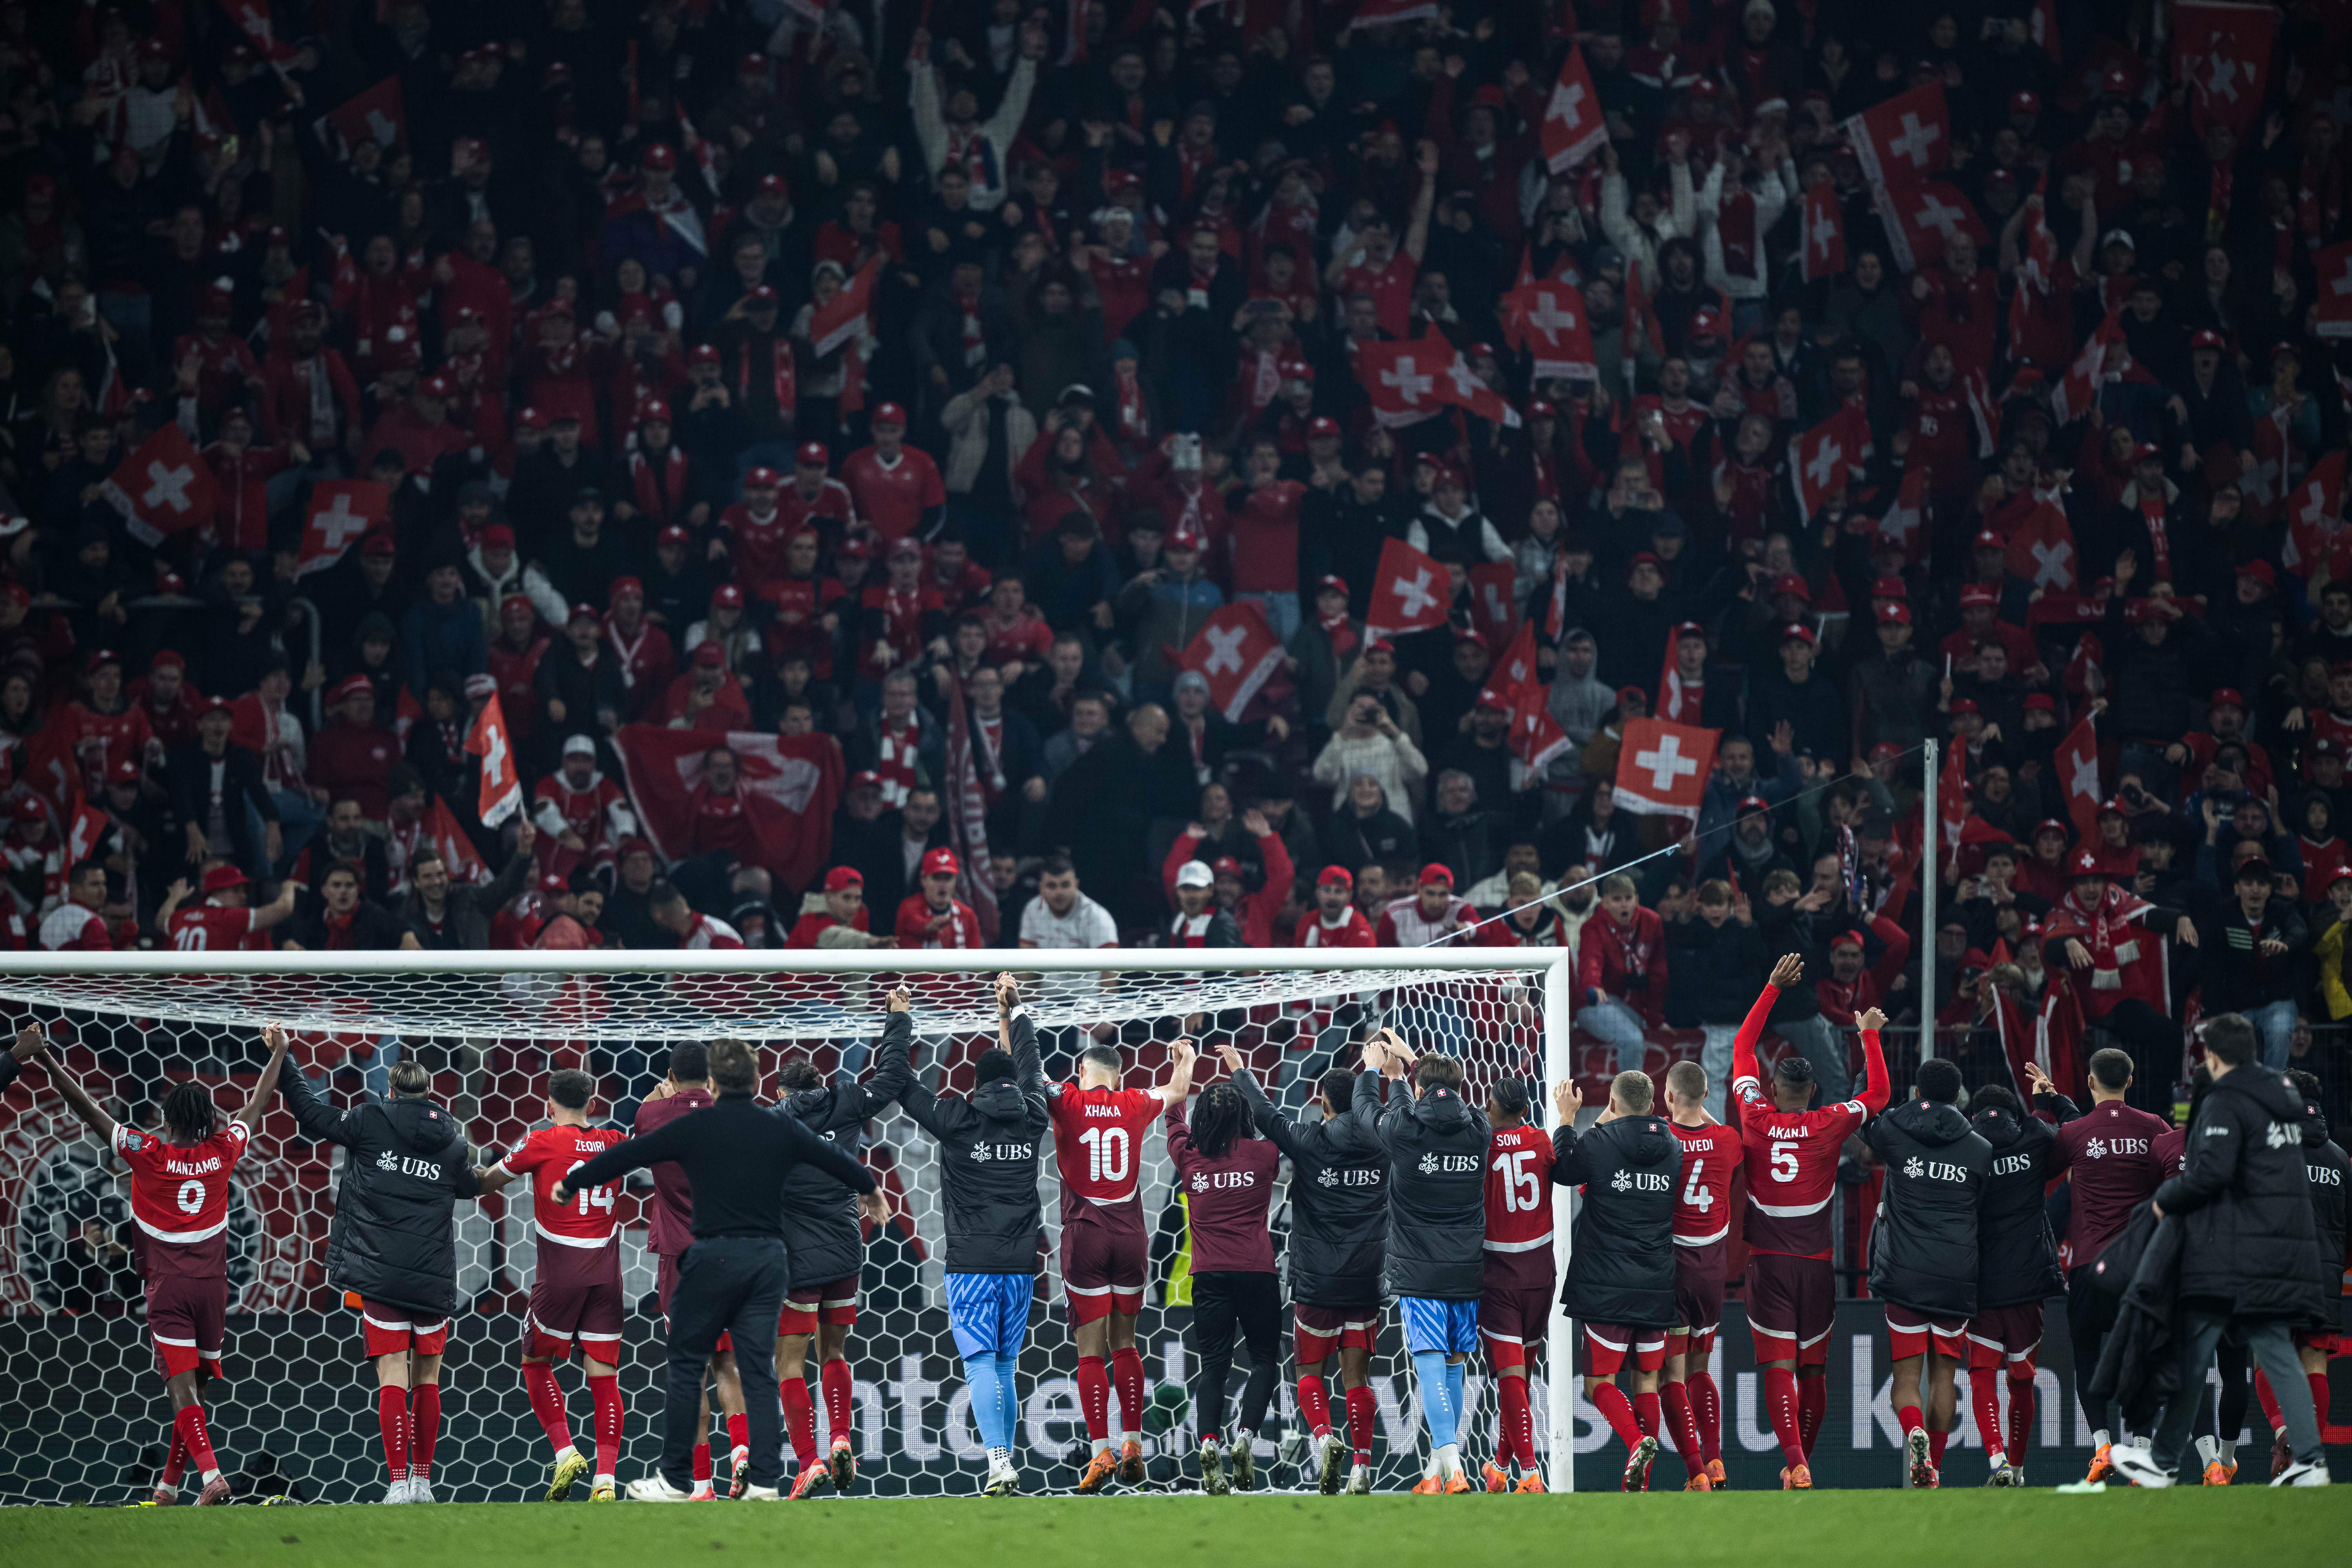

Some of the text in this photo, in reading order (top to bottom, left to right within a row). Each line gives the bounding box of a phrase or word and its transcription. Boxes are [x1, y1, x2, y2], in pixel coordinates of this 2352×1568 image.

[174, 926, 207, 950] 10
[1085, 1104, 1122, 1117] XHAKA
[1496, 1134, 1521, 1147] SOW
[1768, 1125, 1808, 1139] AKANJI
[575, 1139, 605, 1152] ZEQIRI
[996, 1143, 1032, 1160] UBS
[1079, 1127, 1129, 1181] 10
[2109, 1138, 2148, 1154] UBS
[166, 1156, 222, 1176] MANZAMBI
[402, 1157, 441, 1180] UBS
[1443, 1155, 1479, 1171] UBS
[1770, 1141, 1799, 1182] 5
[1994, 1154, 2031, 1175] UBS
[1213, 1171, 1254, 1188] UBS
[1343, 1169, 1380, 1185] UBS
[1492, 1150, 1540, 1212] 15
[1635, 1173, 1670, 1191] UBS
[1929, 1161, 1967, 1183] UBS
[2307, 1165, 2340, 1185] UBS
[566, 1160, 615, 1215] 14
[1683, 1158, 1714, 1213] 4
[177, 1180, 206, 1216] 9
